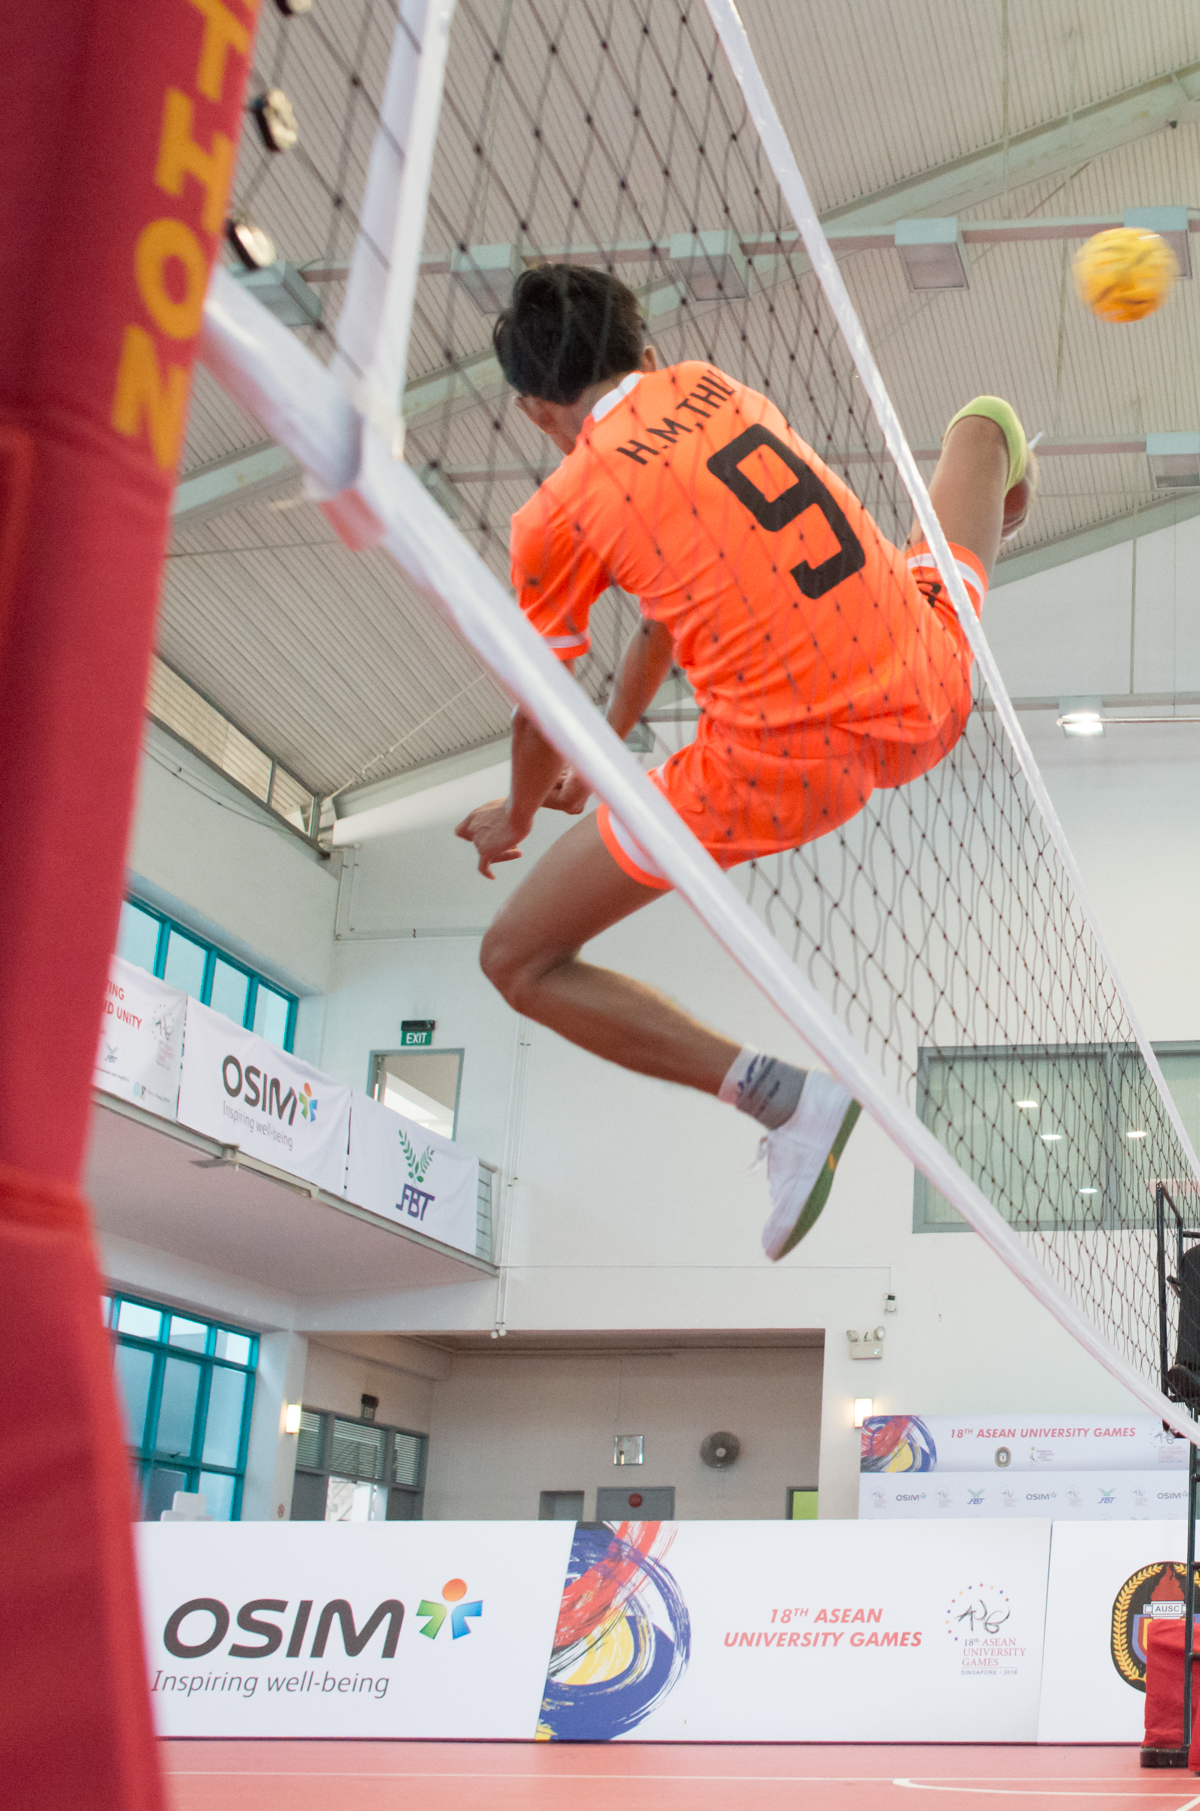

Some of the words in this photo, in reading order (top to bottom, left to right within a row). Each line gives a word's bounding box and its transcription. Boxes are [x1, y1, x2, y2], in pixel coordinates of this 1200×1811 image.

[706, 423, 866, 600] 9
[116, 1005, 142, 1029] UNITY
[406, 1032, 428, 1045] EXIT
[222, 1055, 297, 1126] OSIM
[223, 1100, 254, 1133] Inspiring
[256, 1122, 293, 1151] well-being
[396, 1183, 435, 1221] FBT
[976, 1428, 1017, 1438] ASEAN
[1020, 1428, 1091, 1438] UNIVERSITY
[1093, 1427, 1136, 1437] GAMES
[1157, 1492, 1181, 1500] OSIM
[813, 1608, 883, 1624] ASEAN
[1155, 1605, 1180, 1613] AUSC
[163, 1597, 405, 1659] OSIM
[724, 1632, 844, 1647] UNIVERSITY
[849, 1631, 923, 1647] GAMES
[982, 1638, 1017, 1647] ASEAN
[963, 1647, 1027, 1657] UNIVERSITY
[961, 1658, 999, 1667] GAMES
[151, 1670, 259, 1698] Inspiring
[267, 1670, 390, 1699] well-being
